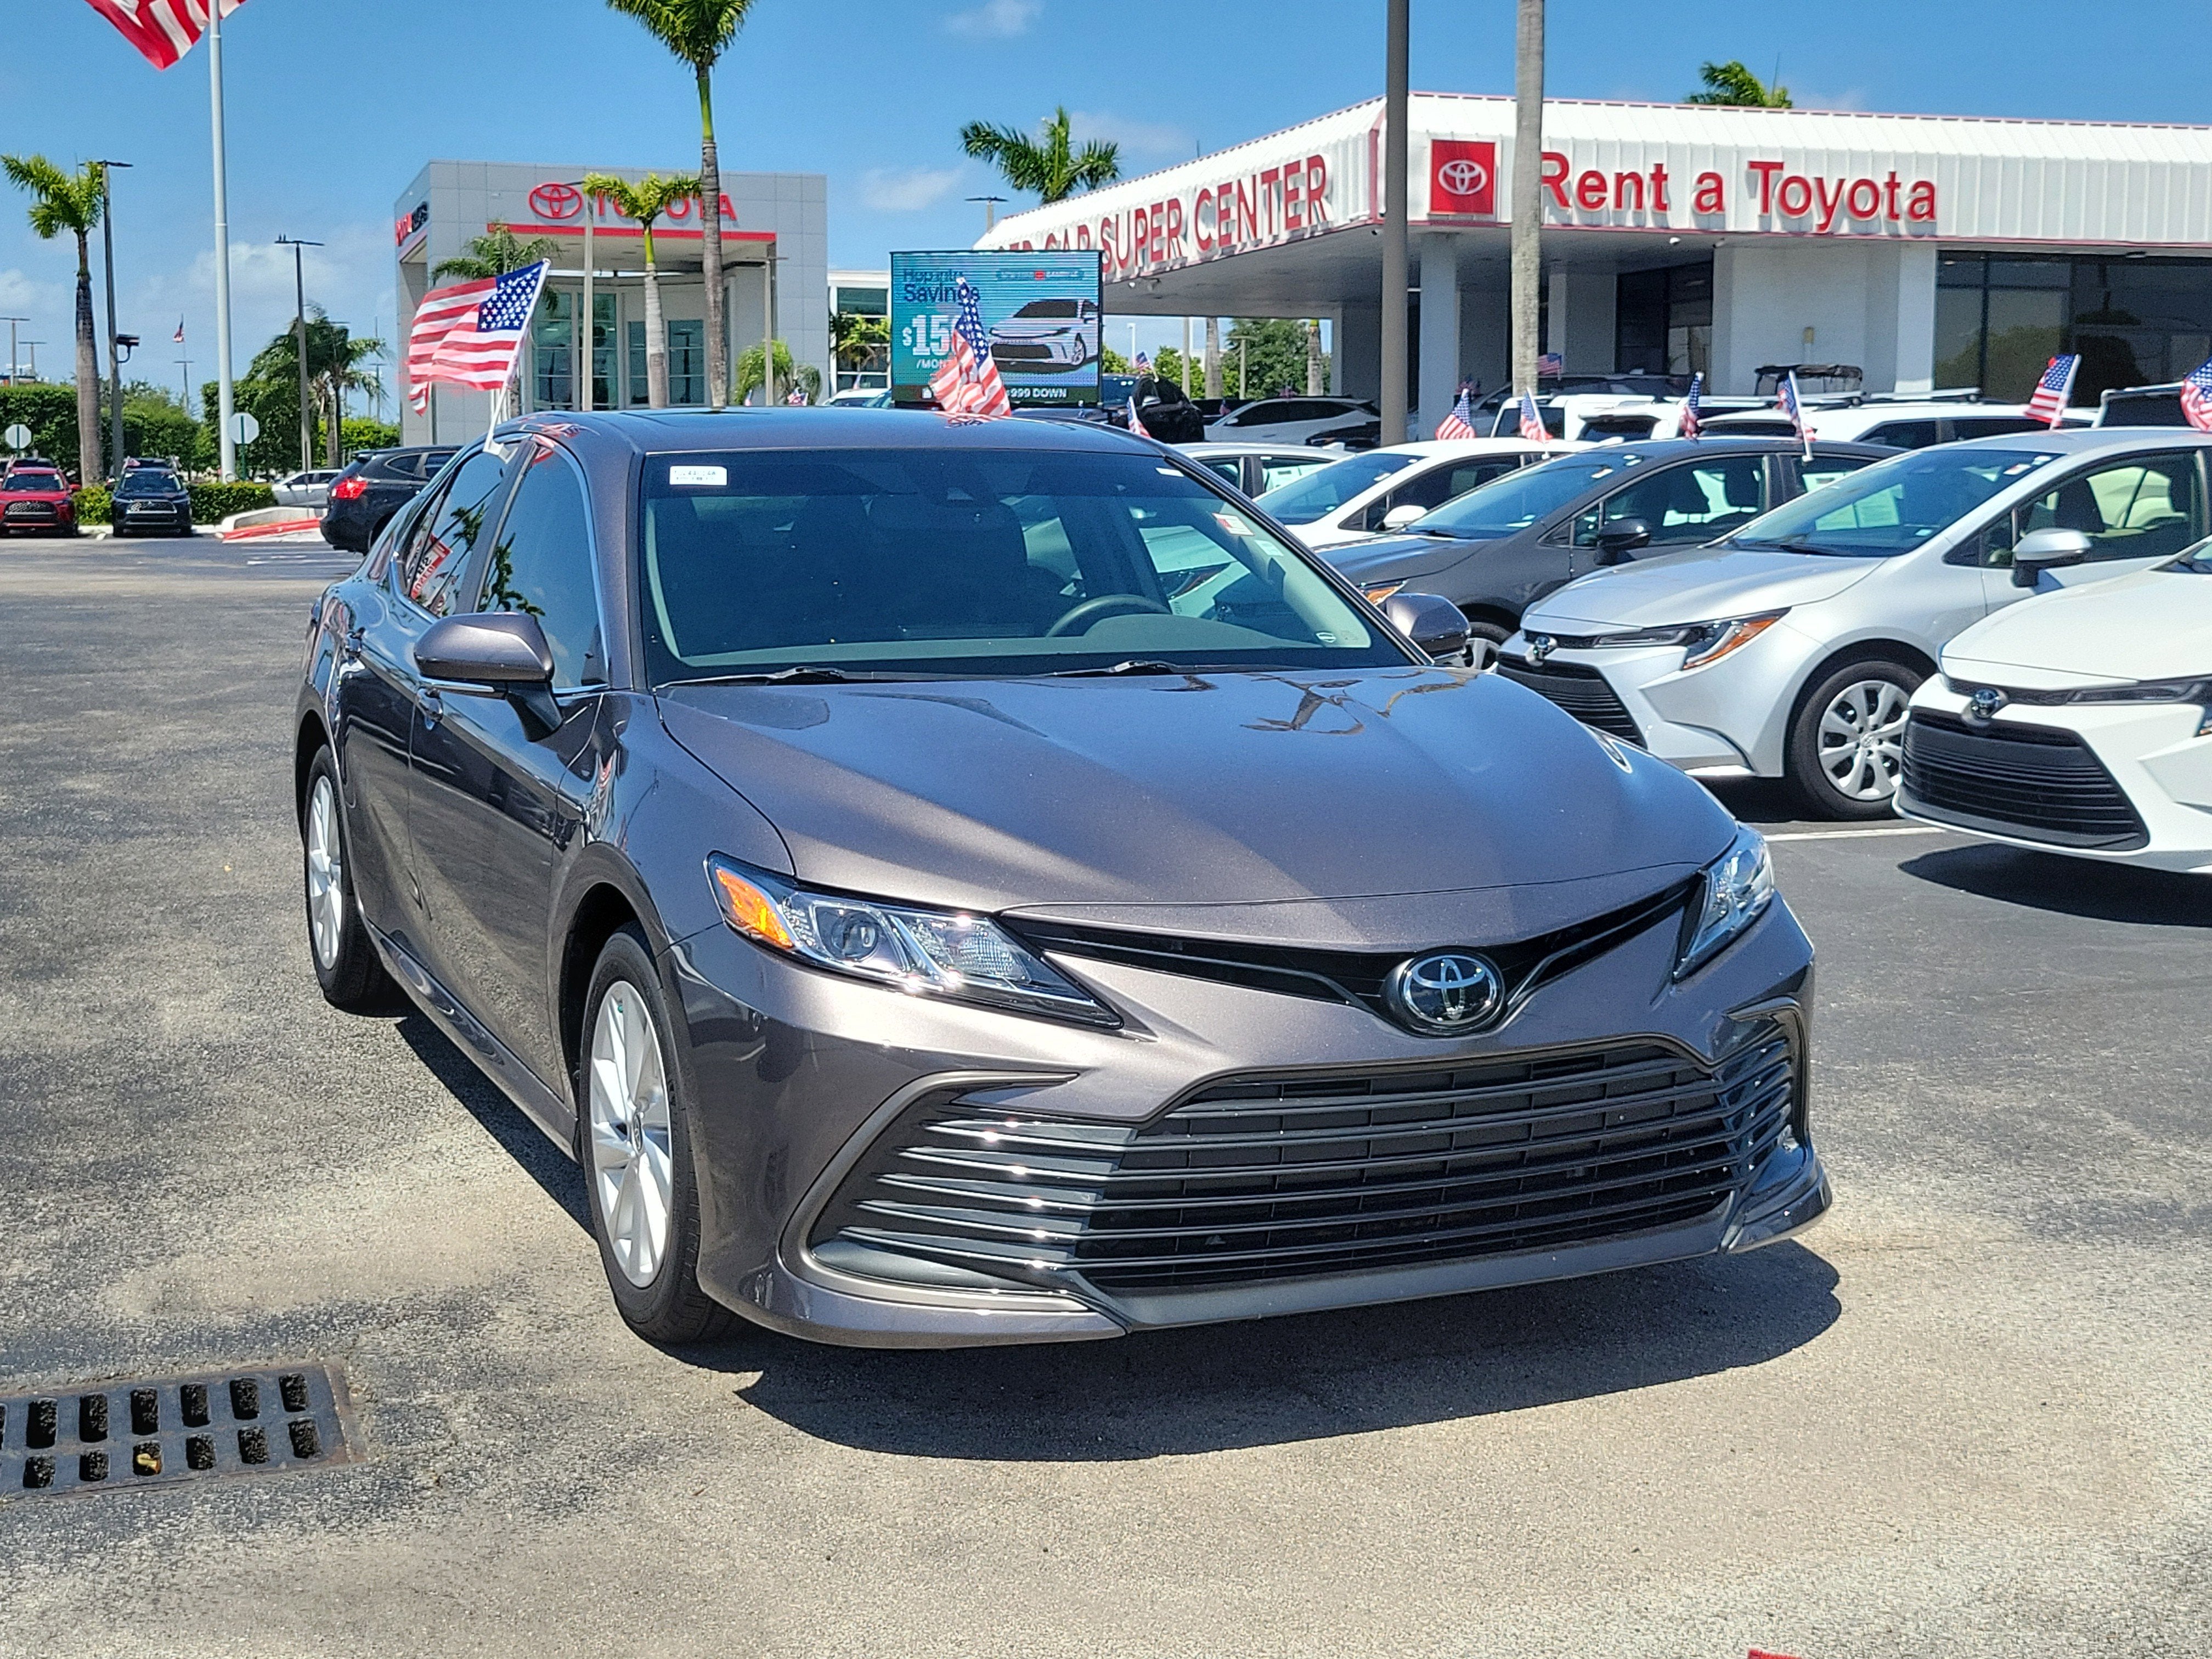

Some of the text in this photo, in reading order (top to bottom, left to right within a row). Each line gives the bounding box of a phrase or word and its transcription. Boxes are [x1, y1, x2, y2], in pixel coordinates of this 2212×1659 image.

[1101, 154, 1328, 273] SUPER CENTER
[1541, 151, 1936, 233] Rent a Toyota
